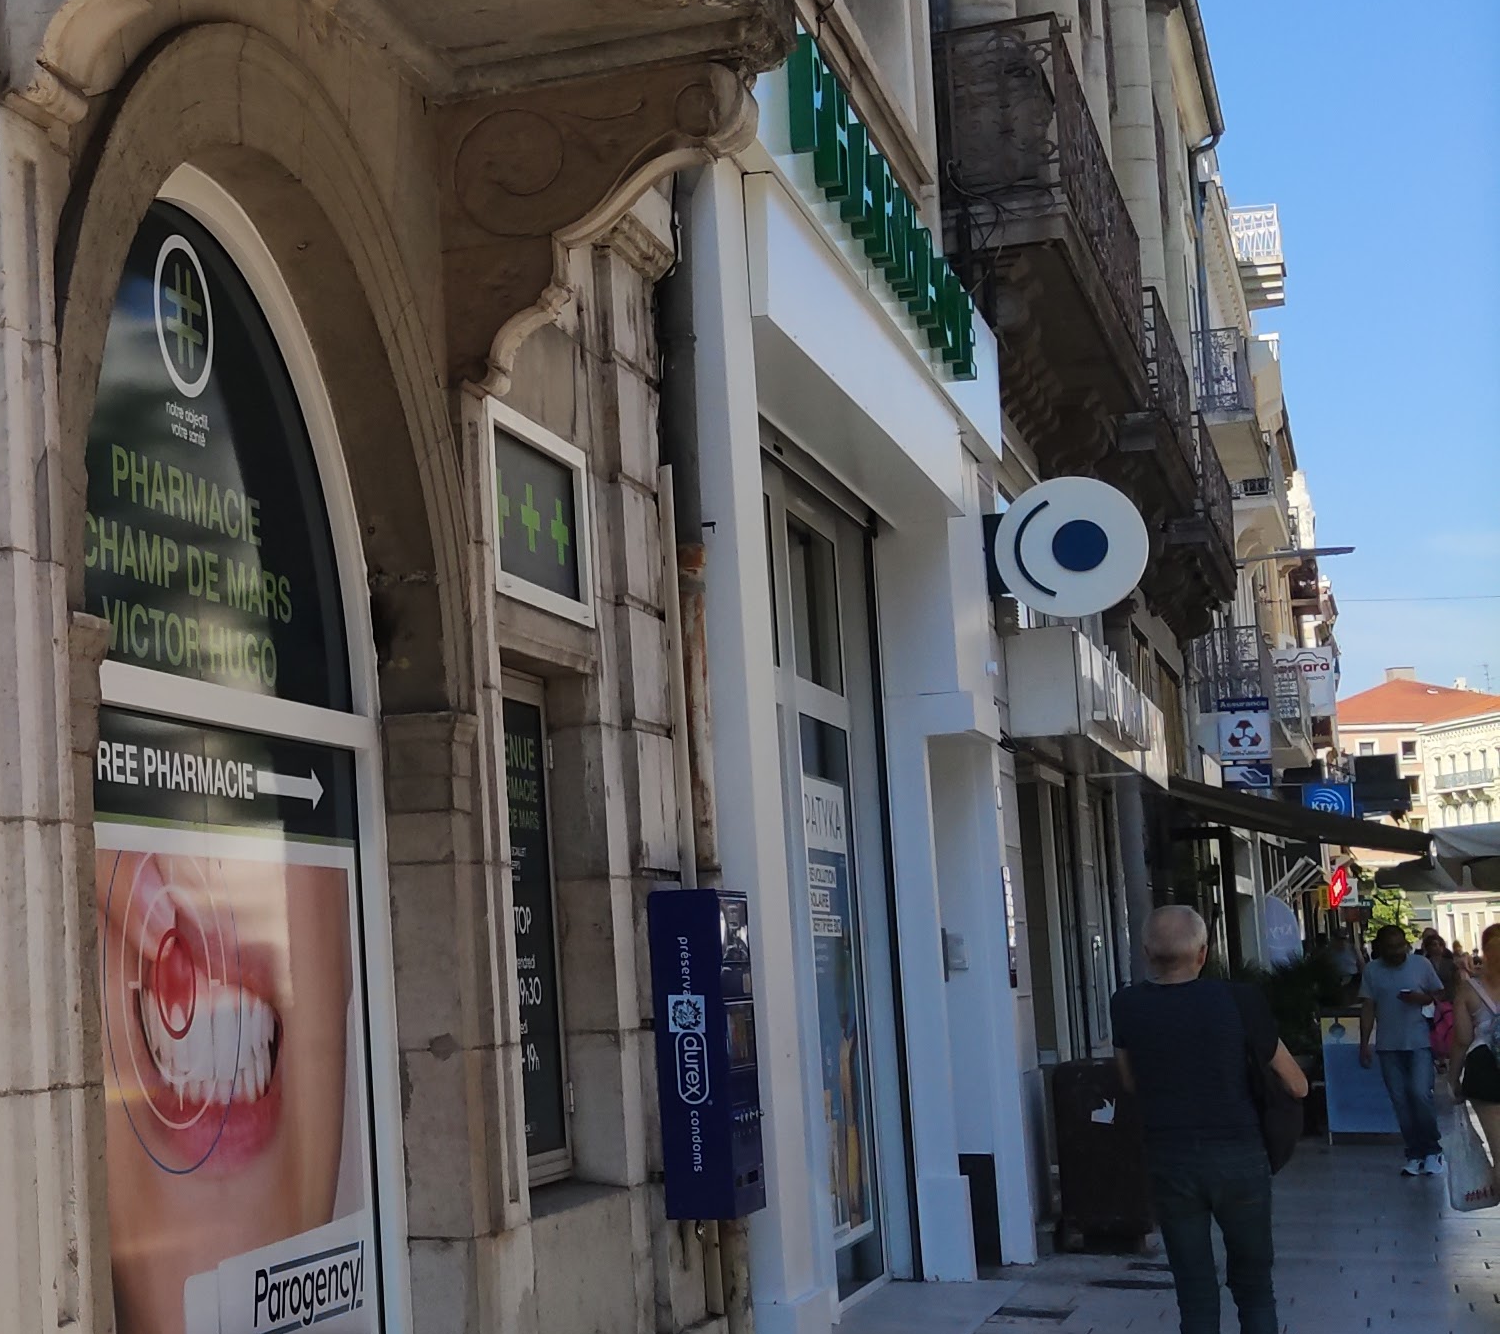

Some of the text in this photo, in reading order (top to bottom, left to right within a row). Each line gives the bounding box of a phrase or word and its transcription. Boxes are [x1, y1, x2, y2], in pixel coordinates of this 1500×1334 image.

[112, 444, 262, 547] PHARMACIE
[85, 511, 292, 624] CHAMP DE MARS
[102, 596, 277, 687] VICTOR HUGO
[144, 747, 255, 800] PHARMACIE
[1311, 800, 1340, 813] Krys
[684, 1034, 702, 1098] durex
[690, 1110, 702, 1172] condoms
[254, 1239, 364, 1326] Parogencyl
